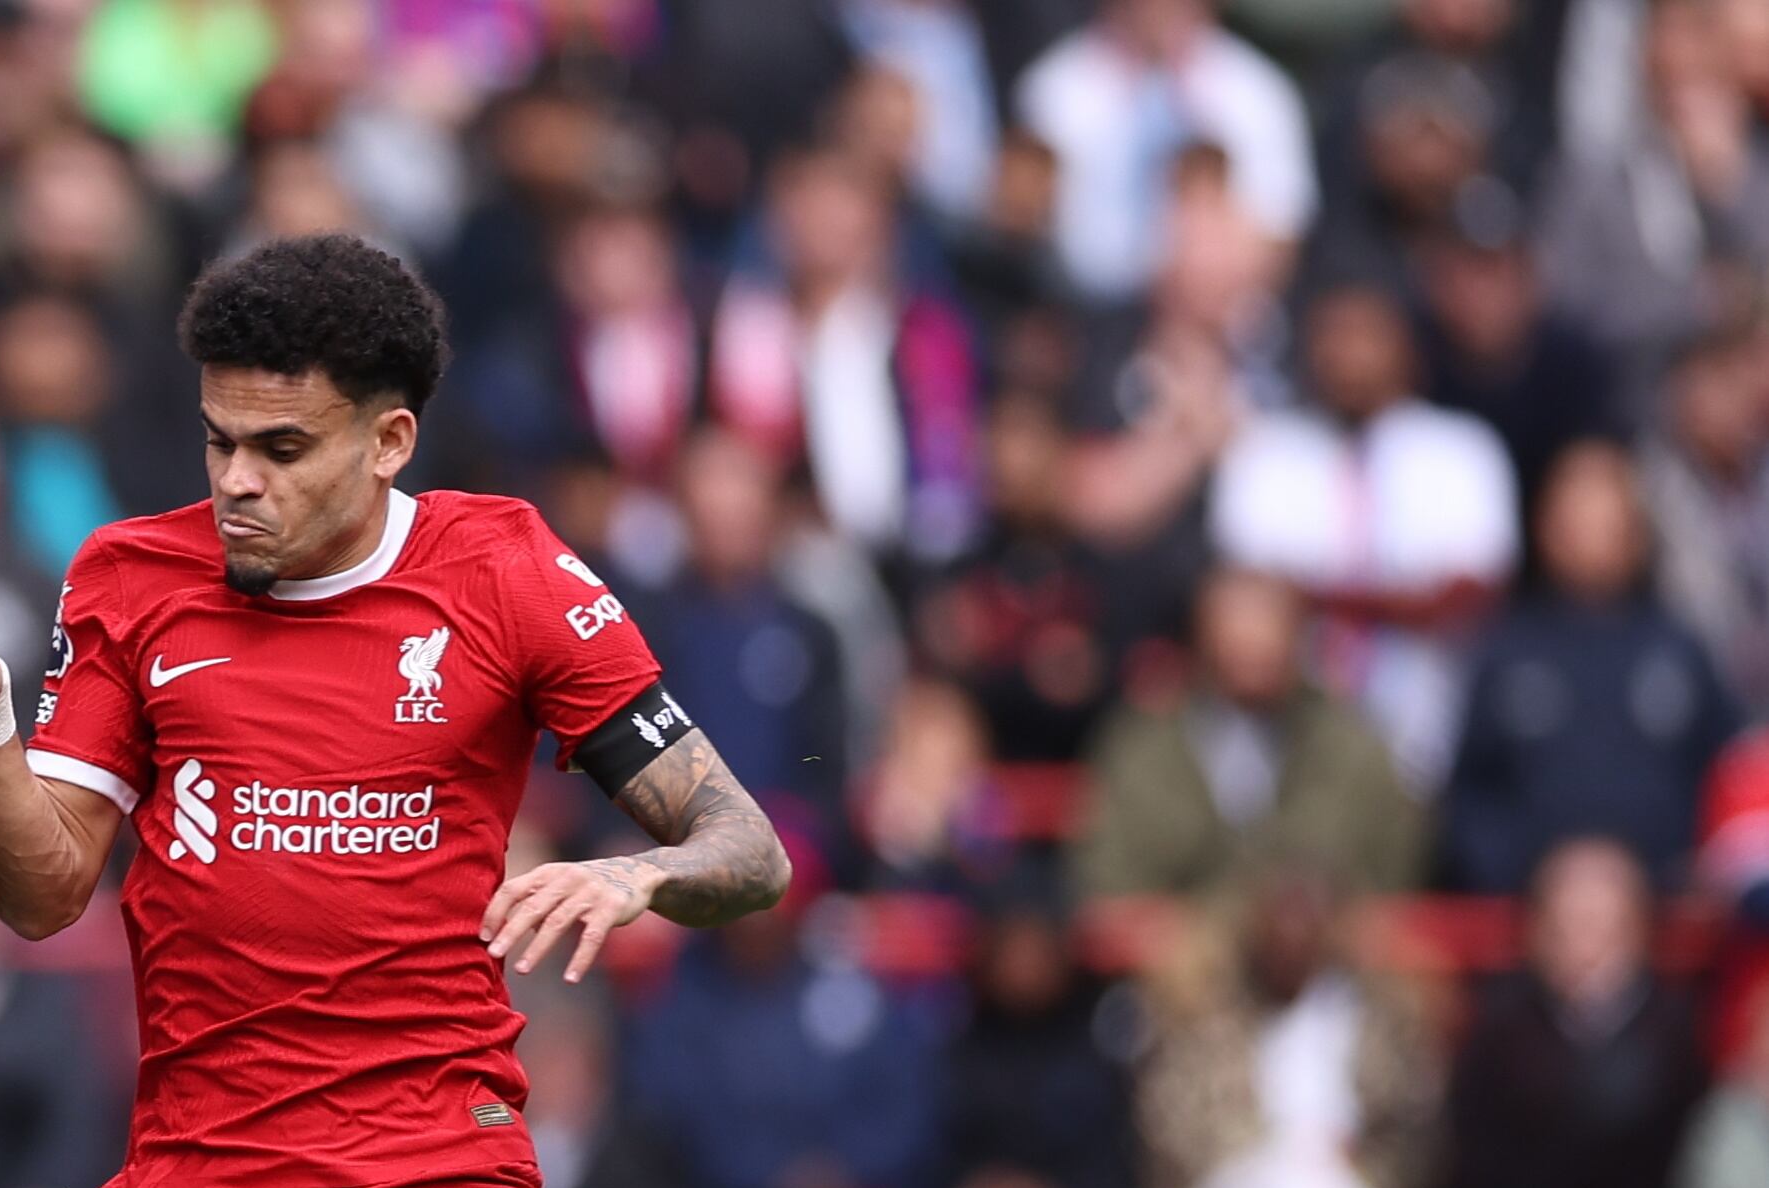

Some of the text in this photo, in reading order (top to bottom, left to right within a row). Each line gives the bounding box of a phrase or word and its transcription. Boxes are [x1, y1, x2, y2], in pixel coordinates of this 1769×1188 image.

[653, 708, 676, 730] 97
[233, 780, 433, 819] standard
[231, 817, 440, 854] chartered
